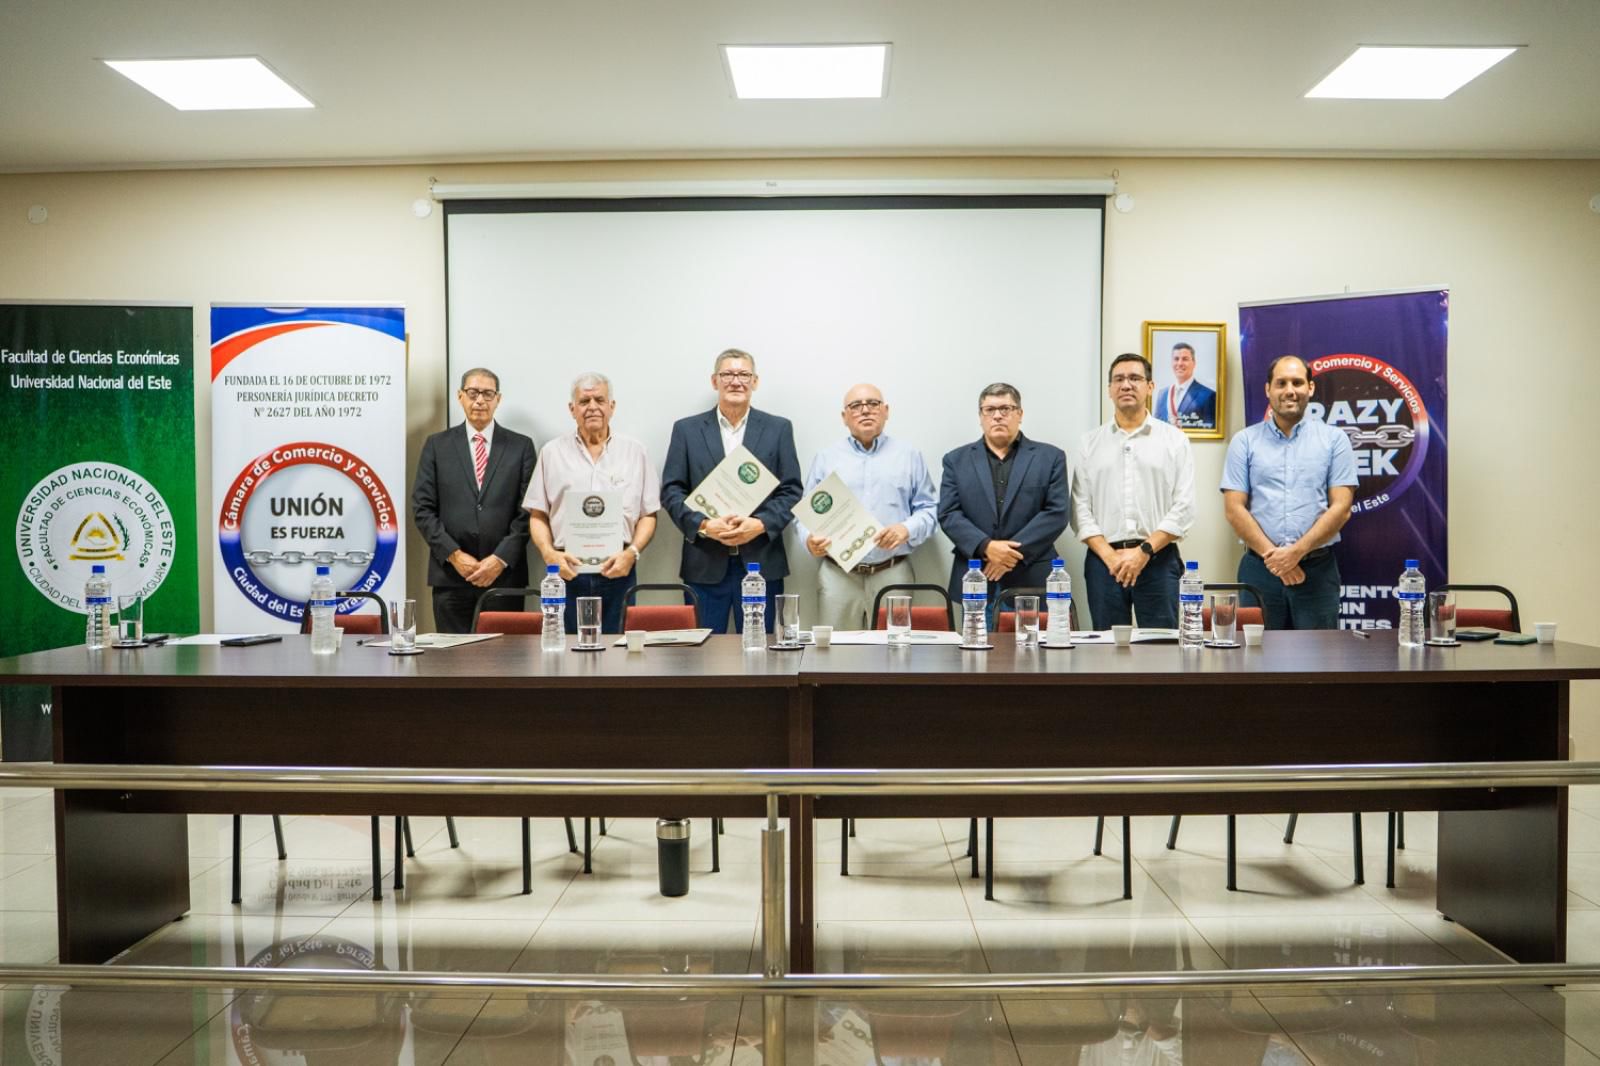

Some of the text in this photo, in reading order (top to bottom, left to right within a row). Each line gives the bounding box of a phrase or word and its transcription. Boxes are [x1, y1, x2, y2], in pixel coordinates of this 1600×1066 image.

[1, 349, 180, 365] Facultad de Ciencias Económicas
[10, 374, 172, 390] Universidad Nacional del Este
[224, 375, 392, 386] FUNDADA EL 16 DE OCTUBRE DE 1972
[1313, 357, 1421, 415] Comercio y Servicios
[237, 389, 379, 403] PERSONERÍA JURÍDICA DECRETO
[267, 407, 291, 417] 2627
[293, 407, 313, 417] DEL
[314, 404, 335, 417] AÑO
[338, 407, 362, 418] 1972
[1305, 398, 1403, 425] RAZY
[1353, 449, 1400, 476] EK
[224, 446, 391, 531] Cámara de Comercio y Servicios
[20, 474, 68, 558] UNIVERSIDAD
[71, 467, 144, 496] NACIONAL
[144, 491, 166, 520] DEL
[160, 520, 173, 558] ESTE
[270, 492, 344, 517] UNIÓN
[1364, 492, 1390, 511] Este
[38, 511, 55, 565] FACULTAD
[50, 496, 66, 511] DE
[66, 486, 121, 500] CIENCIAS
[121, 495, 155, 564] ECONÓMICAS
[270, 526, 345, 540] ES FUERZA
[29, 567, 61, 599] CIUDAD
[60, 595, 82, 609] DEL
[233, 566, 267, 604] Ciudad
[267, 597, 287, 615] del
[1338, 602, 1366, 615] IN
[1338, 618, 1393, 630] ITES
